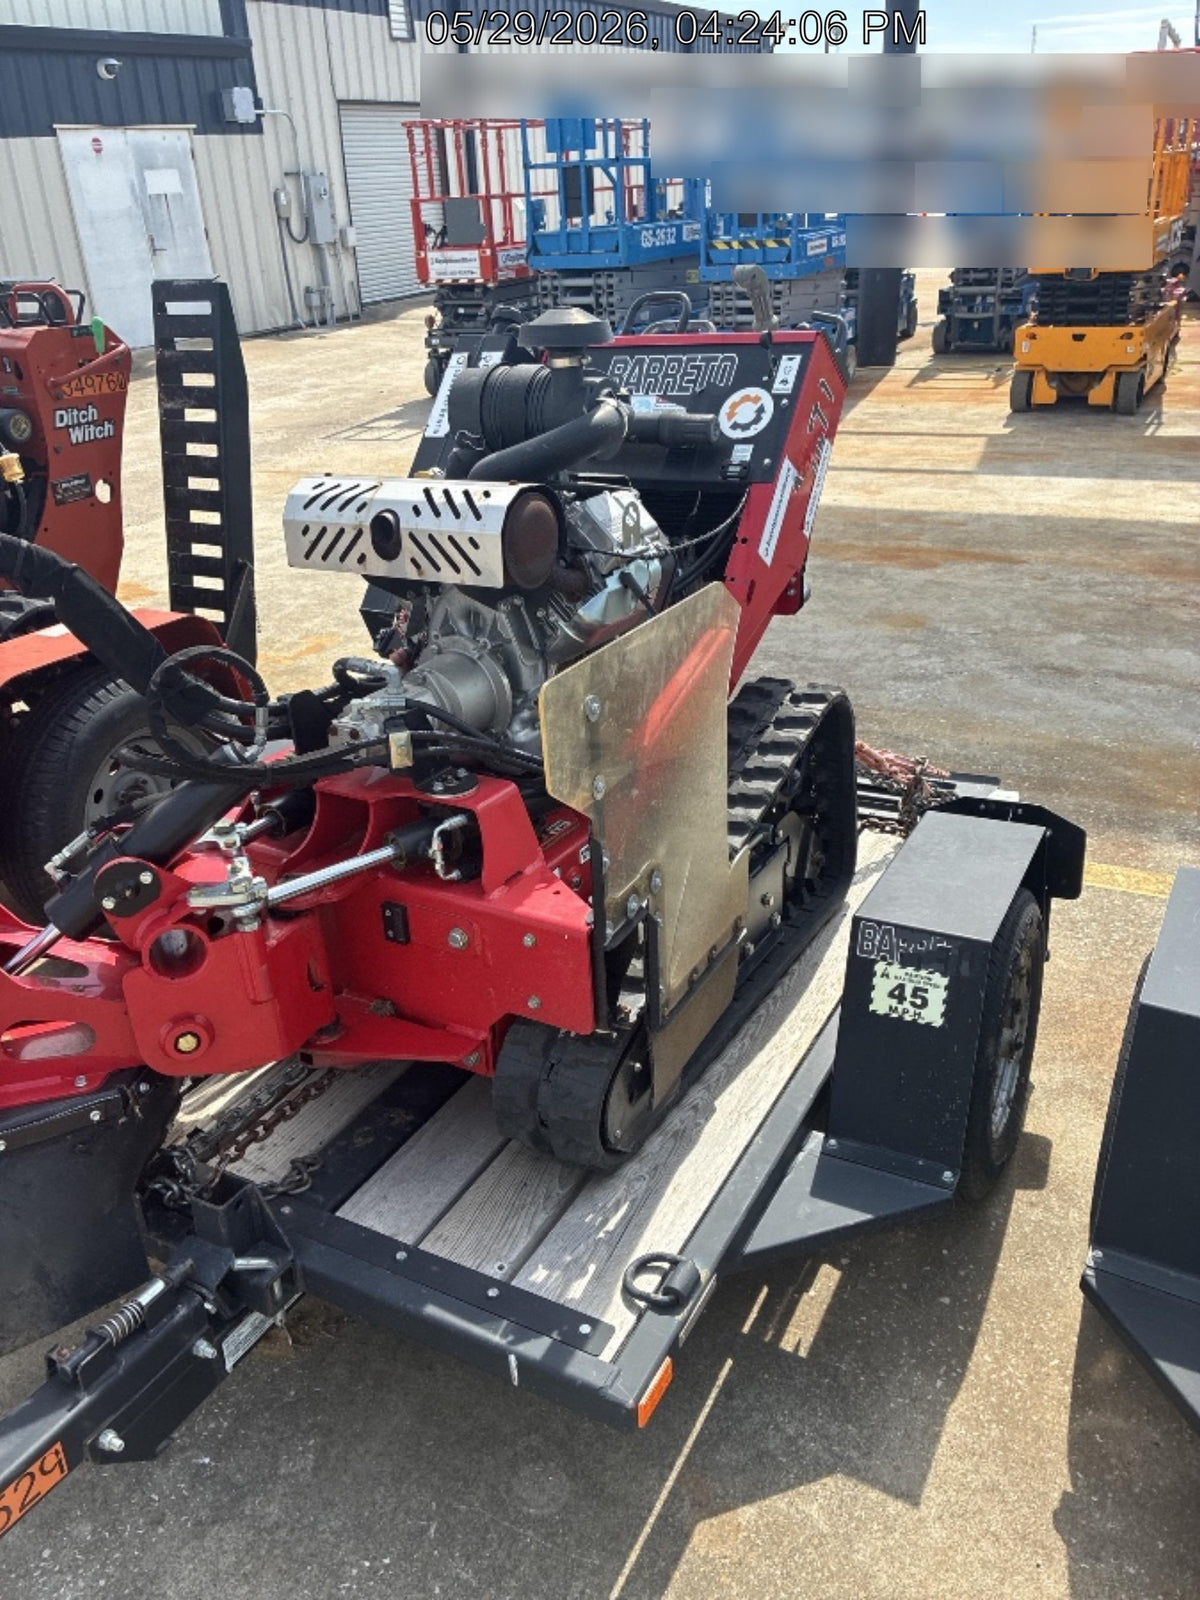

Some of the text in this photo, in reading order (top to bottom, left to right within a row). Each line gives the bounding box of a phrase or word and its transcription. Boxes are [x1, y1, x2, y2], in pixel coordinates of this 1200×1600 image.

[606, 353, 739, 395] BARRETO
[55, 404, 98, 428] Ditch
[69, 420, 115, 444] Witch
[887, 982, 929, 1010] 45
